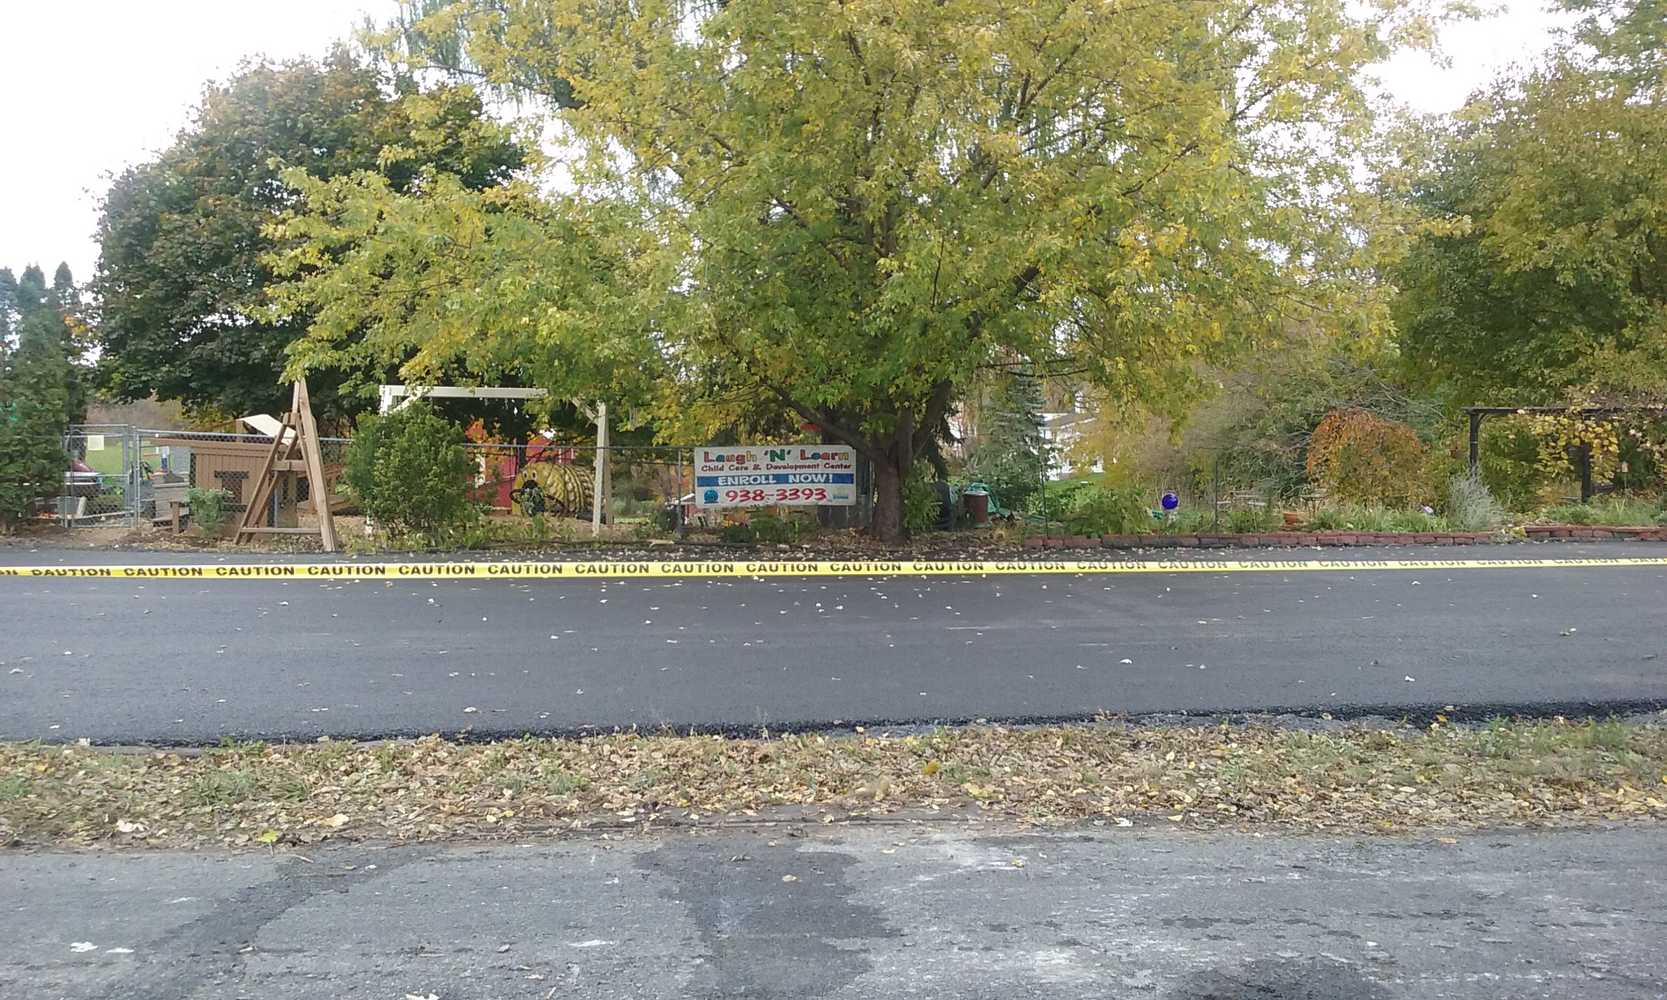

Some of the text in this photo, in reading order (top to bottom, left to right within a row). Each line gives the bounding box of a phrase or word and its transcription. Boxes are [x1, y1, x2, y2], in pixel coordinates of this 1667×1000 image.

[704, 449, 757, 465] Laugh
[800, 449, 849, 461] Learn
[702, 464, 725, 472] Child
[766, 463, 820, 472] Development
[718, 474, 833, 486] ENROLL NOW!
[725, 487, 828, 502] 938-3393
[31, 569, 112, 577] CAUTION
[124, 567, 203, 577] CAUTION
[216, 566, 295, 576] CAUTION
[307, 566, 386, 576] CAUTION
[399, 565, 475, 575] CAUTION
[487, 564, 563, 574] CAUTION
[575, 564, 649, 574] CAUTION
[661, 563, 734, 574] CAUTION
[746, 563, 818, 573] CAUTION
[831, 563, 901, 572] CAUTION
[913, 562, 984, 571] CAUTION
[995, 562, 1065, 571] CAUTION
[1077, 561, 1146, 571] CAUTION
[1158, 561, 1228, 570] CAUTION
